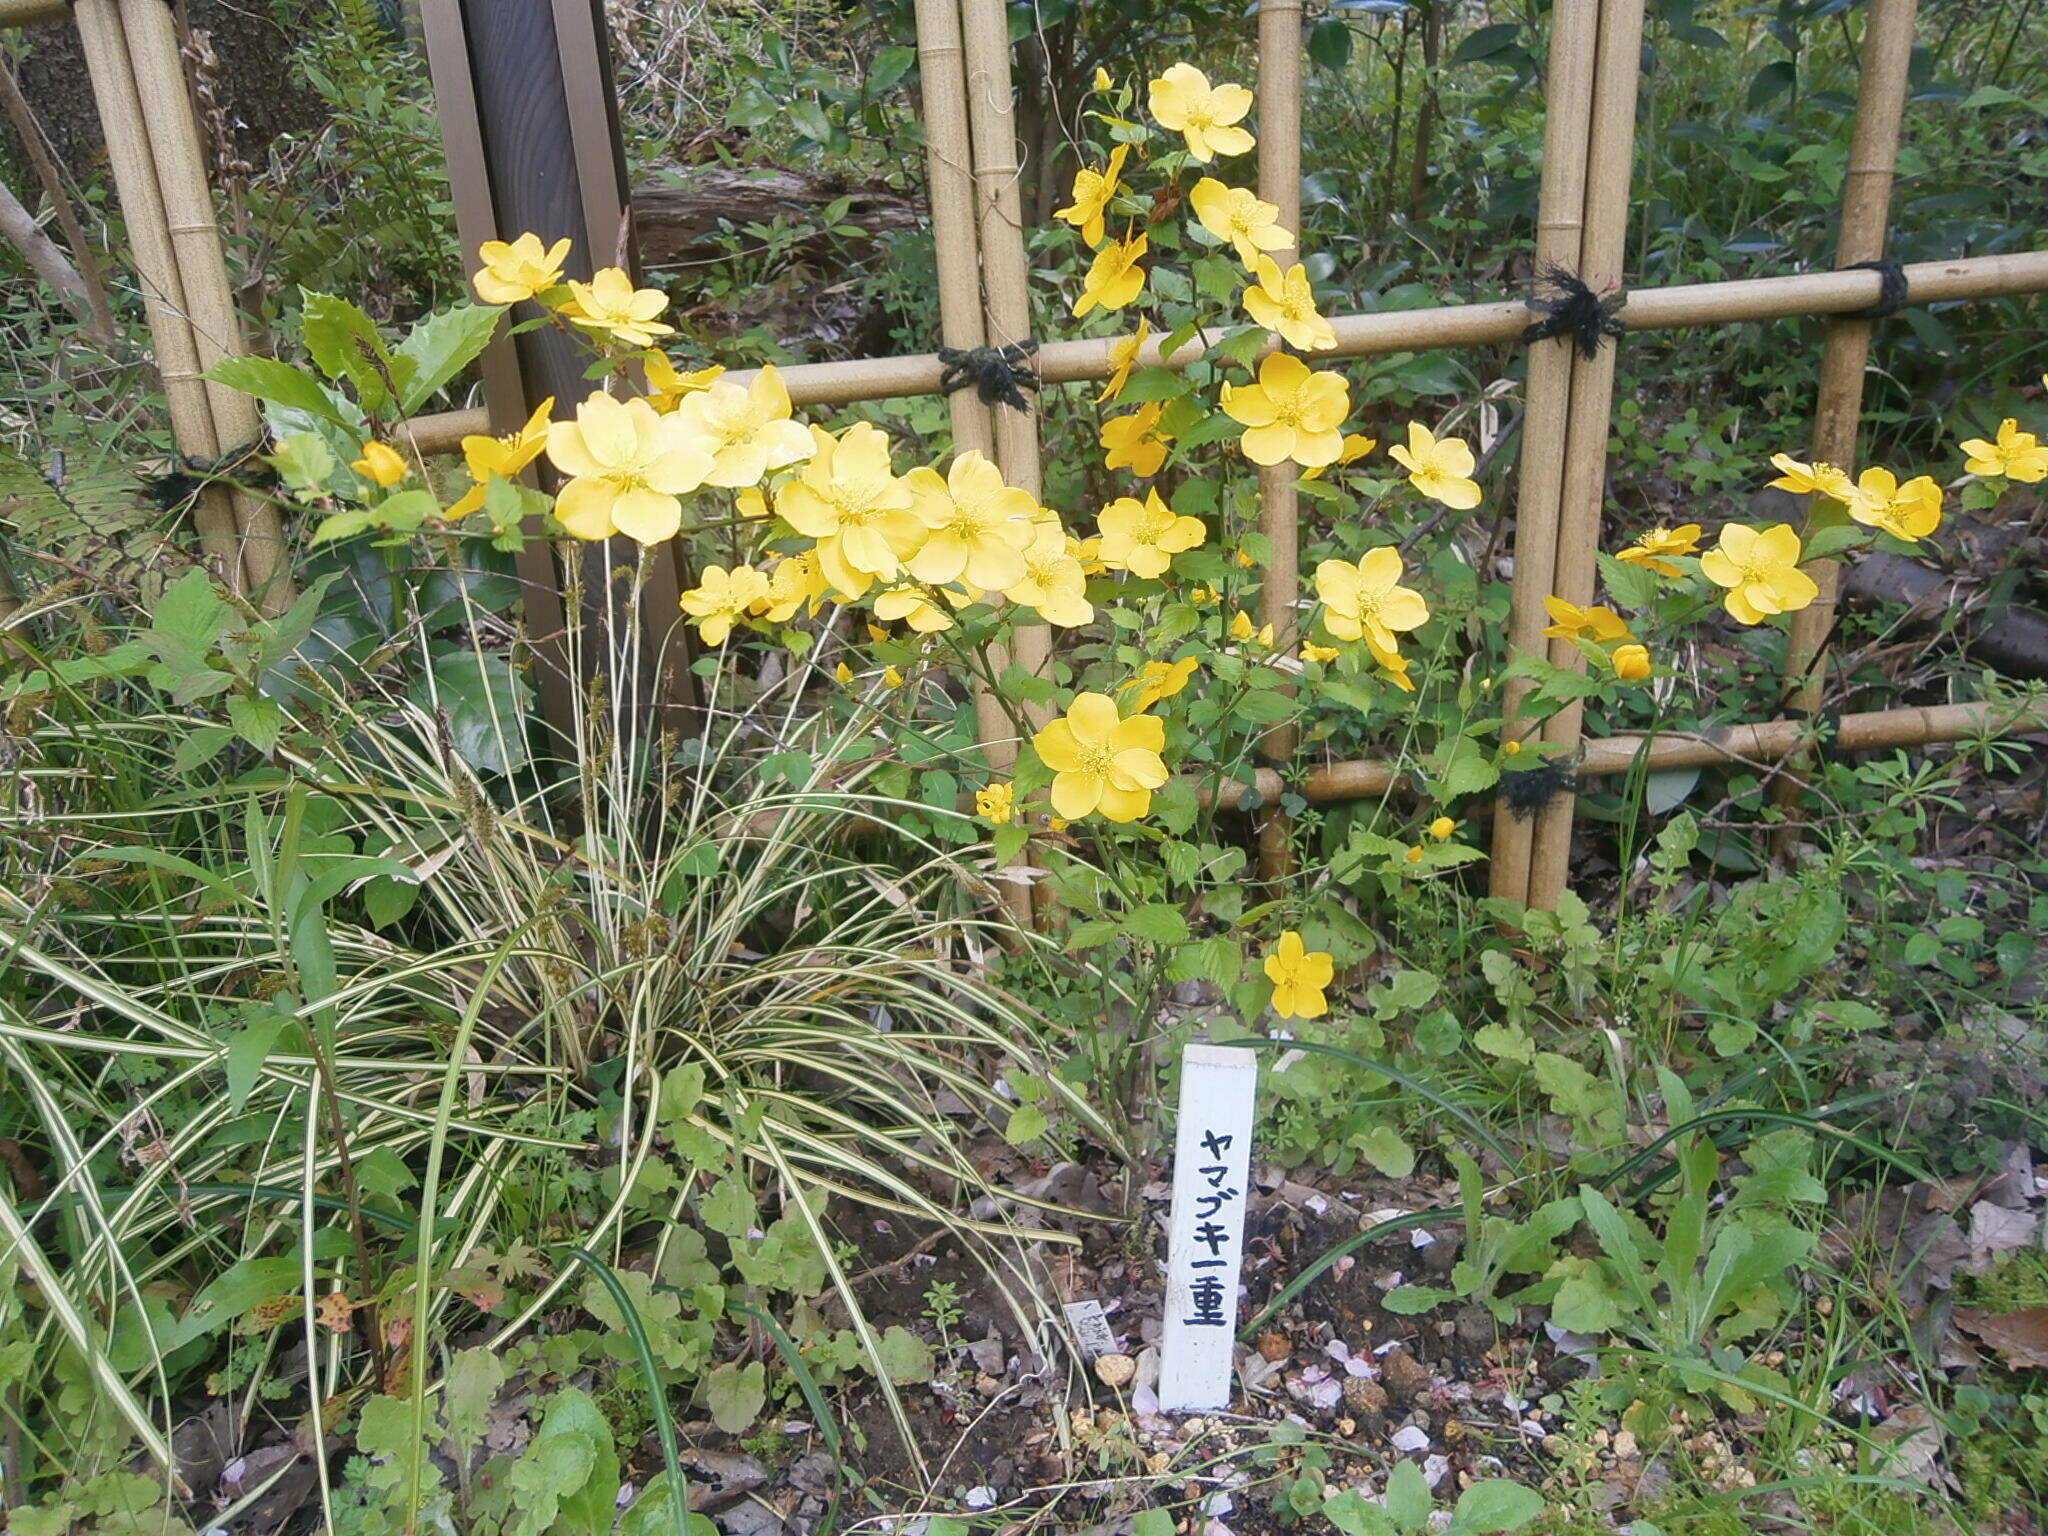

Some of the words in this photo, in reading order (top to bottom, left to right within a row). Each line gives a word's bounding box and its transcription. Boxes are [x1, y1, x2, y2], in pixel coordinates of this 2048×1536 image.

[1183, 1129, 1239, 1326] ヤマブキ一重
